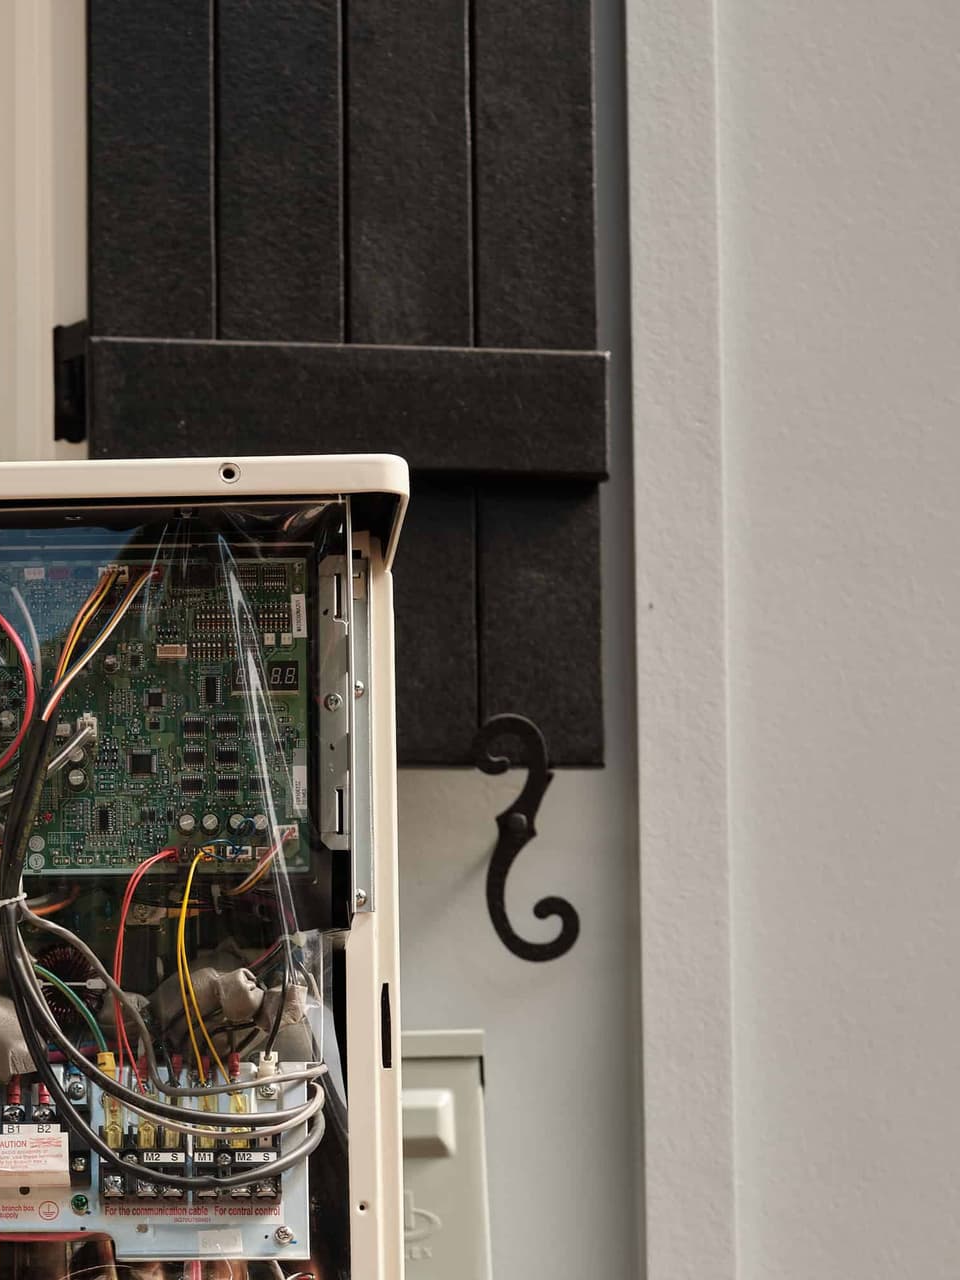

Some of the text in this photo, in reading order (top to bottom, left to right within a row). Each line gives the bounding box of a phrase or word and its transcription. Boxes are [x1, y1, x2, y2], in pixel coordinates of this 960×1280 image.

[7, 1124, 51, 1134] B1 B2
[145, 1153, 178, 1161] M2 S
[198, 1152, 212, 1161] M1
[237, 1152, 270, 1161] M2 S
[104, 1206, 208, 1216] For the communication cable
[214, 1206, 280, 1216] For central control
